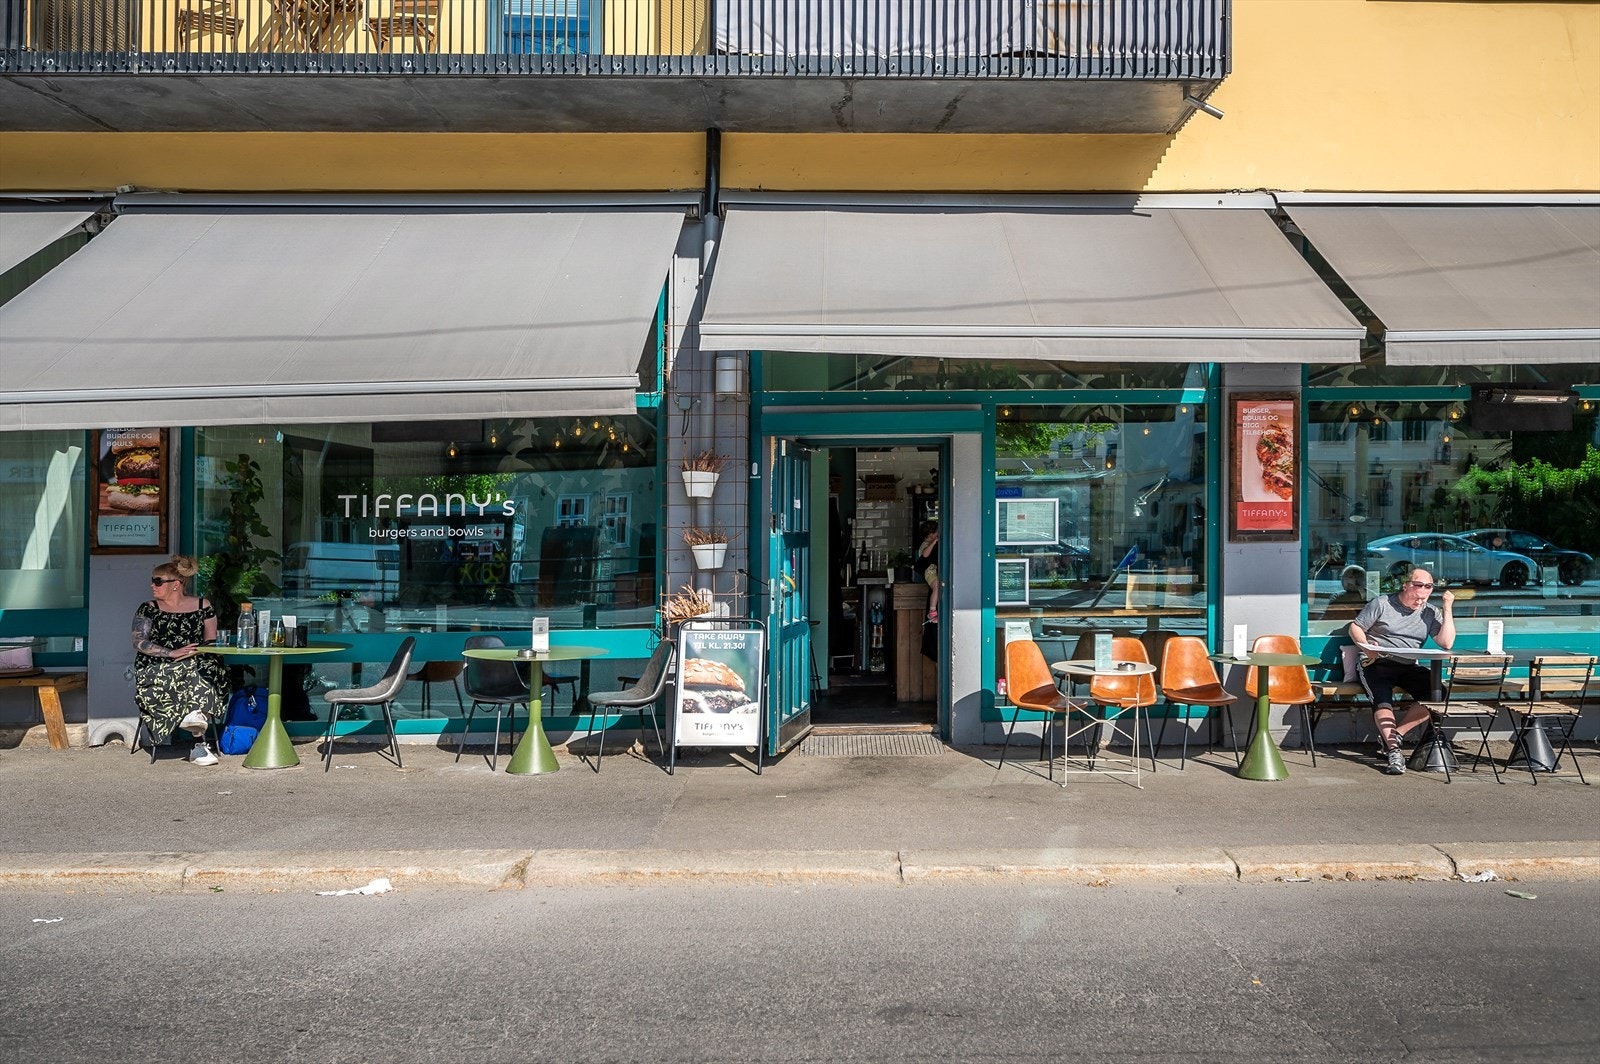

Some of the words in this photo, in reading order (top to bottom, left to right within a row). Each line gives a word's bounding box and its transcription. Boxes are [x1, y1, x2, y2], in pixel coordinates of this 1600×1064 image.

[337, 493, 516, 518] TIFFANY's
[1242, 509, 1288, 517] TIFFANY's
[103, 524, 155, 532] TIFFANY's
[368, 527, 417, 540] burgers
[420, 526, 444, 537] and
[448, 525, 484, 537] bowls
[723, 642, 746, 650] 21.30!
[694, 722, 744, 731] TIFNY's
